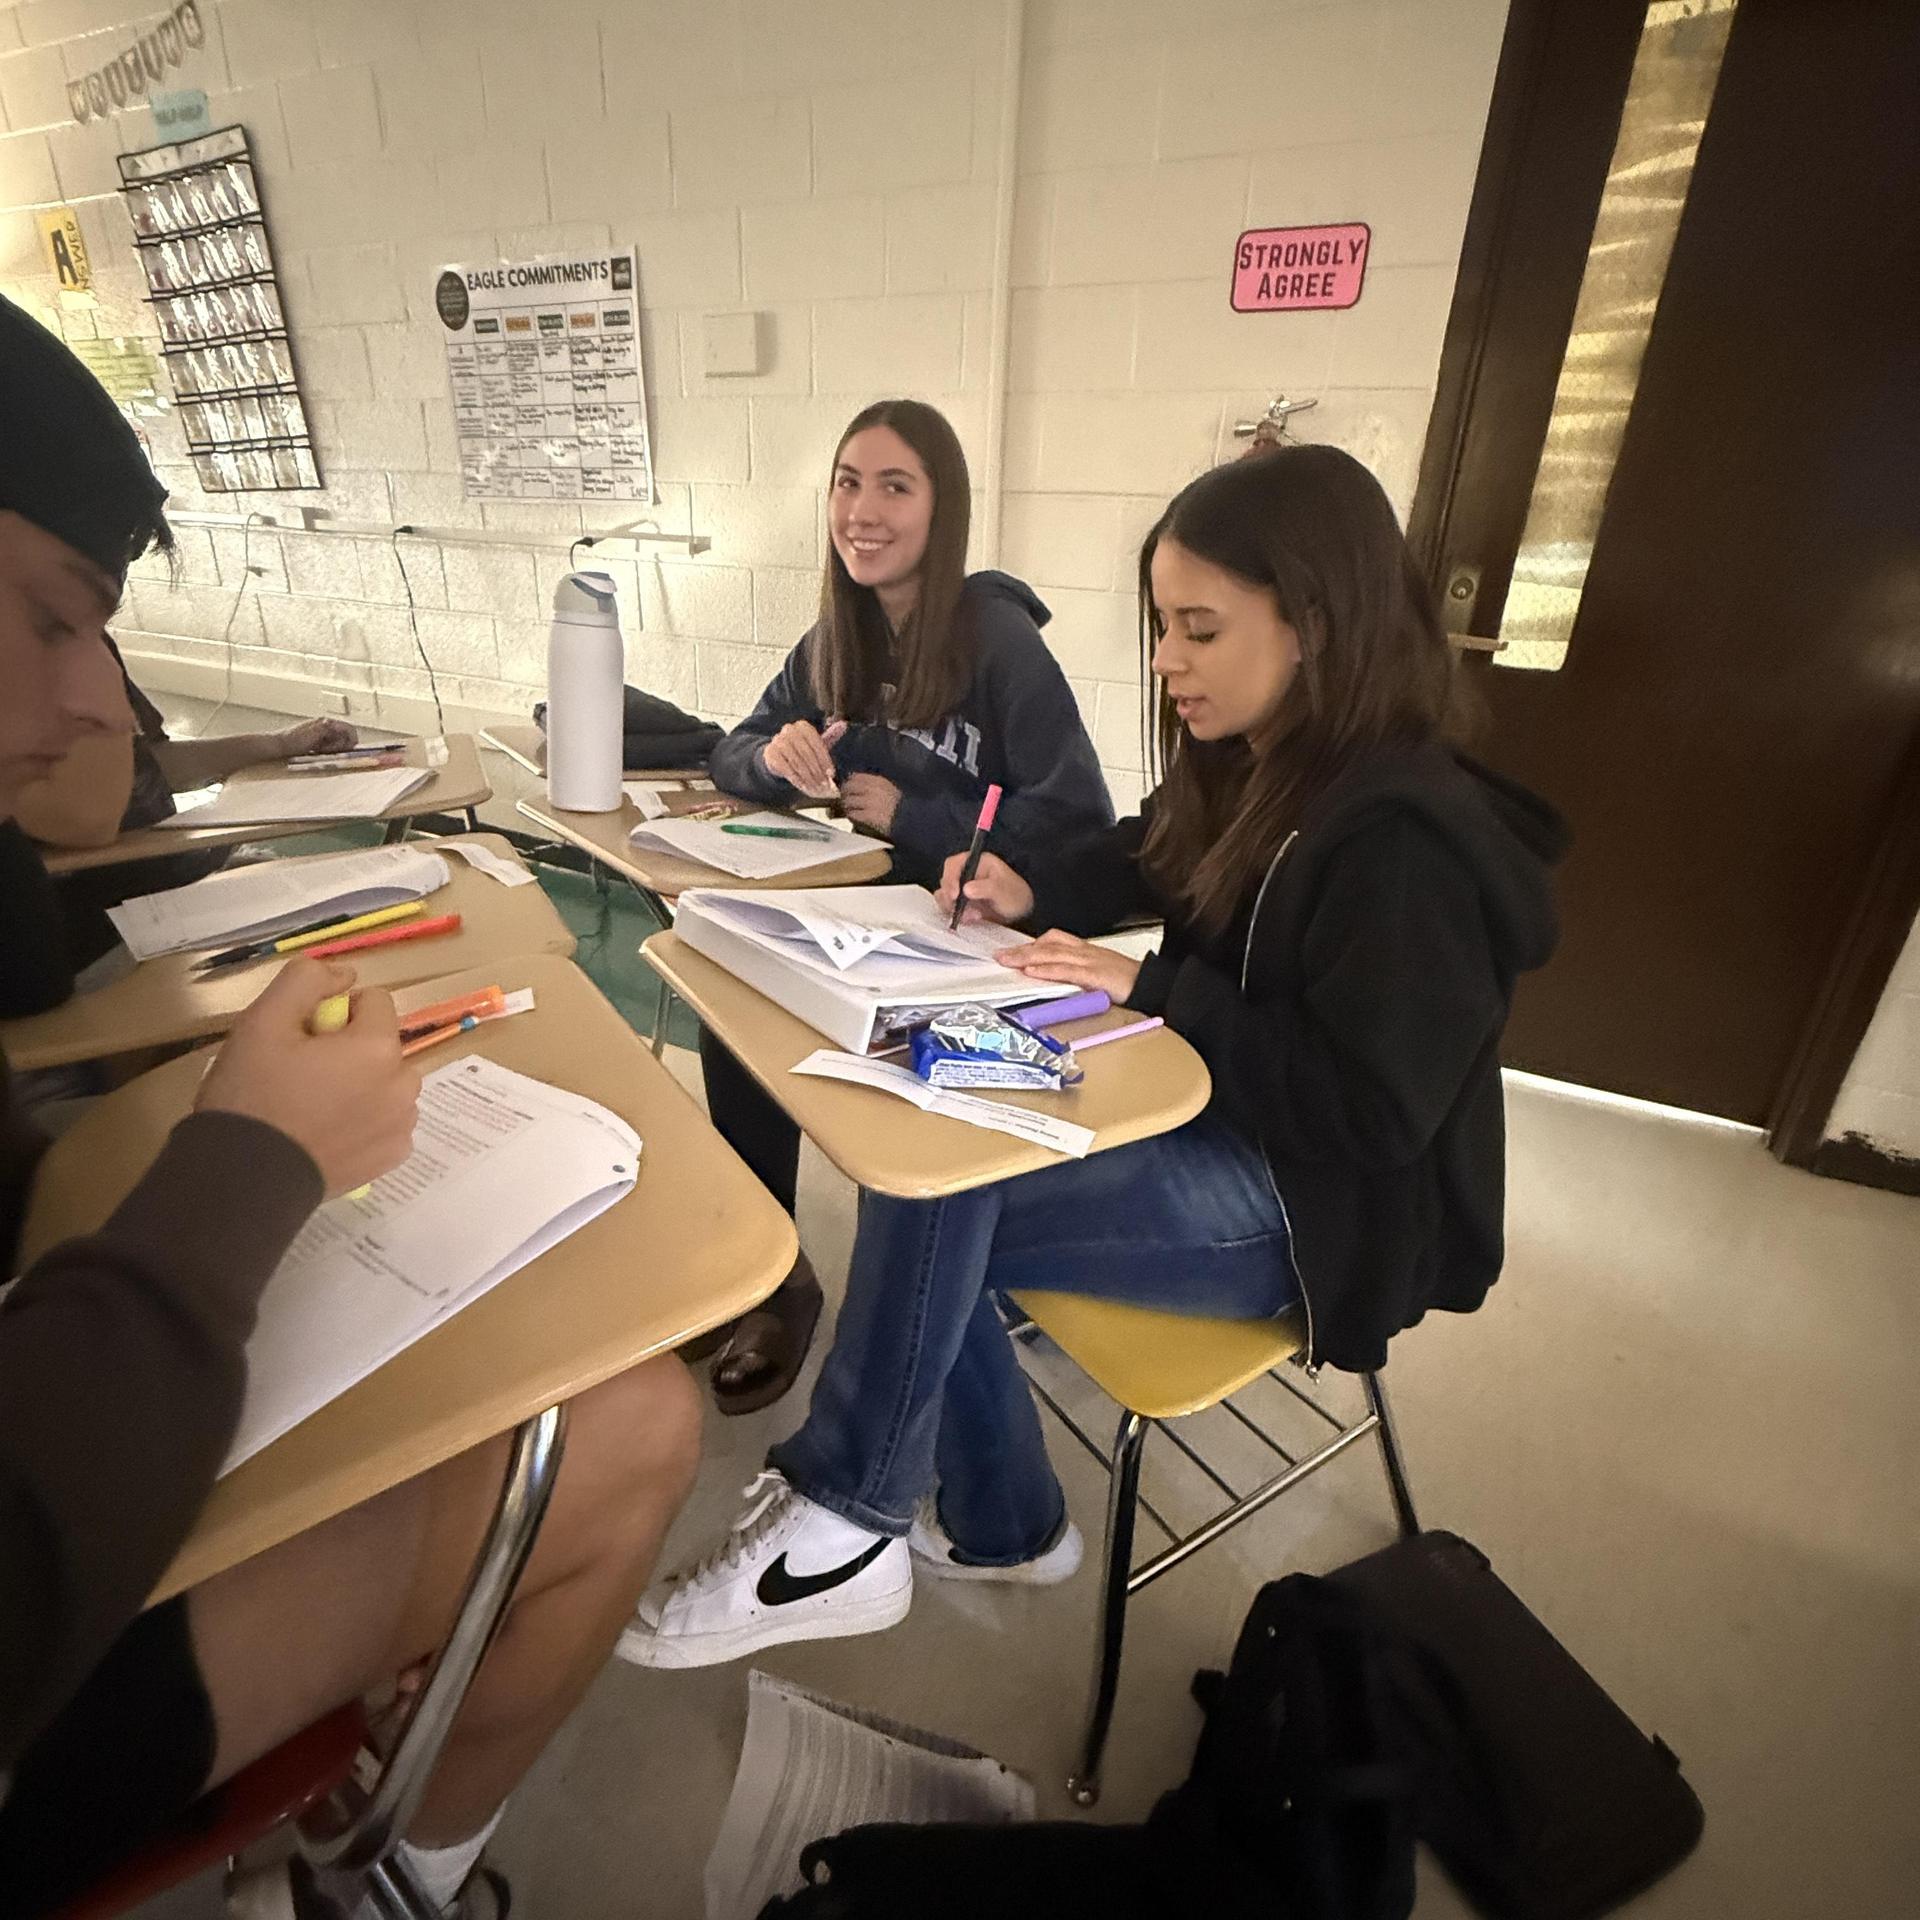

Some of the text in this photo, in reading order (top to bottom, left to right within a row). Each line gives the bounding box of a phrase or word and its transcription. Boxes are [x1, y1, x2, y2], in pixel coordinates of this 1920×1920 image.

[1239, 239, 1364, 270] STRONGLY
[467, 271, 505, 291] EAGLE
[507, 260, 609, 287] COMMITMENTS
[1257, 272, 1337, 300] AGREE
